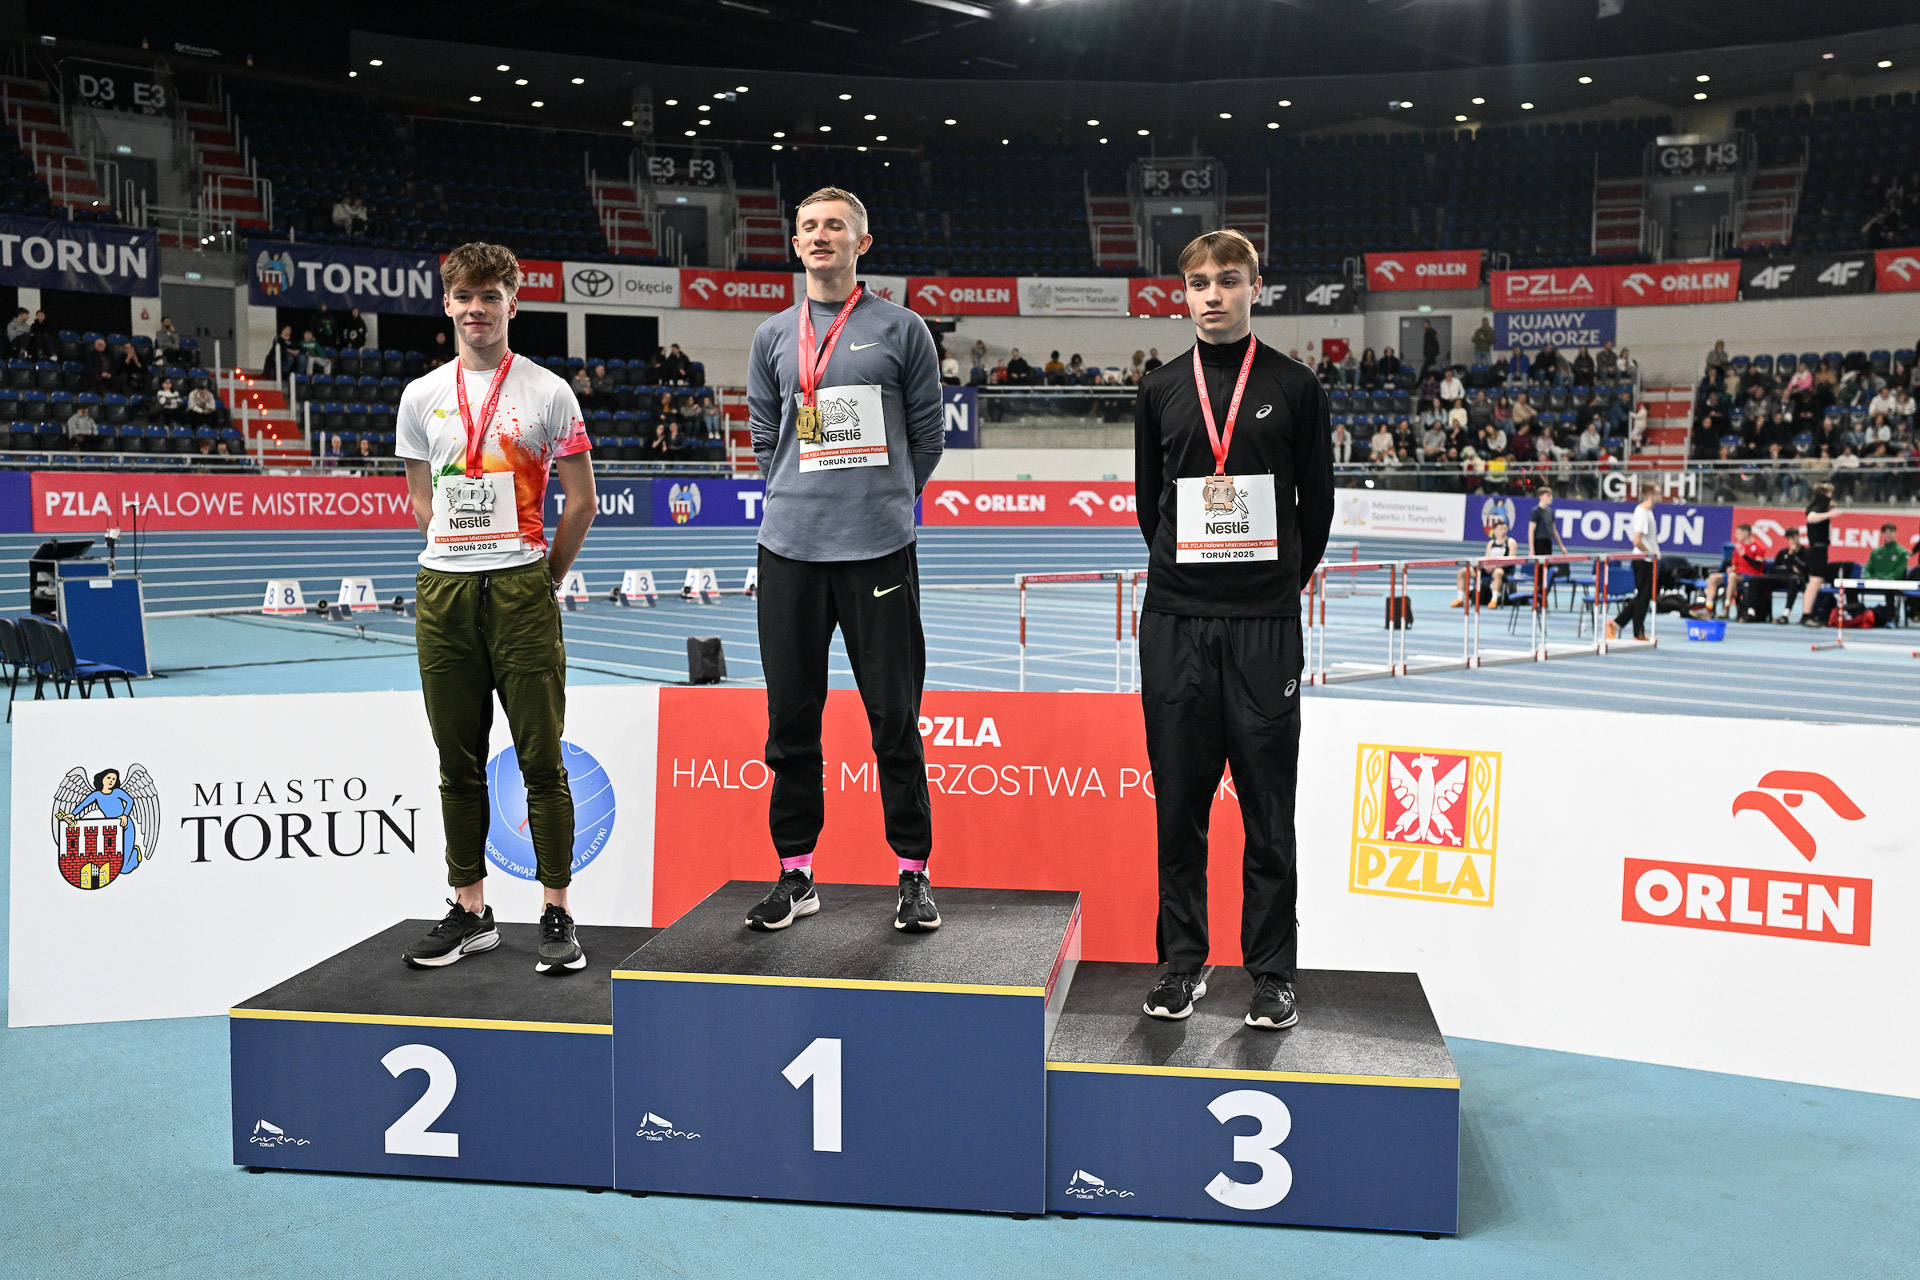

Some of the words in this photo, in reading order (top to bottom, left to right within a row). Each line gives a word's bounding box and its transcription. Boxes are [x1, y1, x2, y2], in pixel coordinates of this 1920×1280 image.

[79, 74, 115, 101] D3
[133, 82, 166, 108] E3
[1661, 146, 1694, 169] G3
[1705, 143, 1738, 166] H3
[648, 156, 675, 177] E3
[689, 159, 715, 180] F3
[1181, 170, 1211, 190] G3
[0, 233, 147, 279] TORUŃ
[298, 260, 433, 299] TORUŃ
[1415, 263, 1467, 277] ORLEN
[1750, 264, 1796, 290] 4F
[1817, 260, 1866, 286] 4F
[520, 272, 553, 288] LEN
[625, 280, 673, 294] Okęcie
[1506, 273, 1594, 296] PZLA
[1661, 273, 1731, 291] ORLEN
[723, 282, 785, 298] ORLEN
[950, 288, 1010, 303] ORLEN
[1305, 284, 1345, 306] 4F
[1508, 312, 1586, 330] KUJAWY
[1508, 329, 1600, 347] POMORZE
[818, 456, 846, 466] TORUŃ
[847, 456, 868, 464] 2025
[1603, 471, 1638, 498] G1
[1663, 471, 1697, 498] H1
[45, 491, 112, 517] PZLA
[121, 491, 243, 517] HALOWE
[252, 491, 415, 516] MISTRZOSTW
[975, 494, 1046, 512] ORLEN
[448, 542, 476, 552] TORUŃ
[477, 542, 498, 551] 2025
[1201, 549, 1231, 559] TORUŃ
[570, 578, 580, 594] 4
[626, 576, 632, 592] 3
[640, 576, 649, 592] 3
[702, 574, 711, 590] 2
[268, 588, 275, 605] 8
[284, 587, 296, 605] 8
[356, 585, 367, 602] 7
[918, 715, 1002, 747] PZLA
[673, 758, 828, 791] HALO
[840, 761, 1107, 798] MIRZOSTWA
[193, 777, 368, 807] MIASTO
[181, 794, 421, 864] TORUŃ
[580, 827, 608, 863] ATLETYKI
[1356, 844, 1486, 898] PZLA
[1634, 868, 1856, 935] ORLEN
[380, 1043, 460, 1158] 2
[780, 1037, 842, 1153] 1
[249, 1135, 310, 1146] arena
[636, 1128, 701, 1140] arena
[1204, 1089, 1293, 1210] 3
[1065, 1186, 1135, 1198] arena
